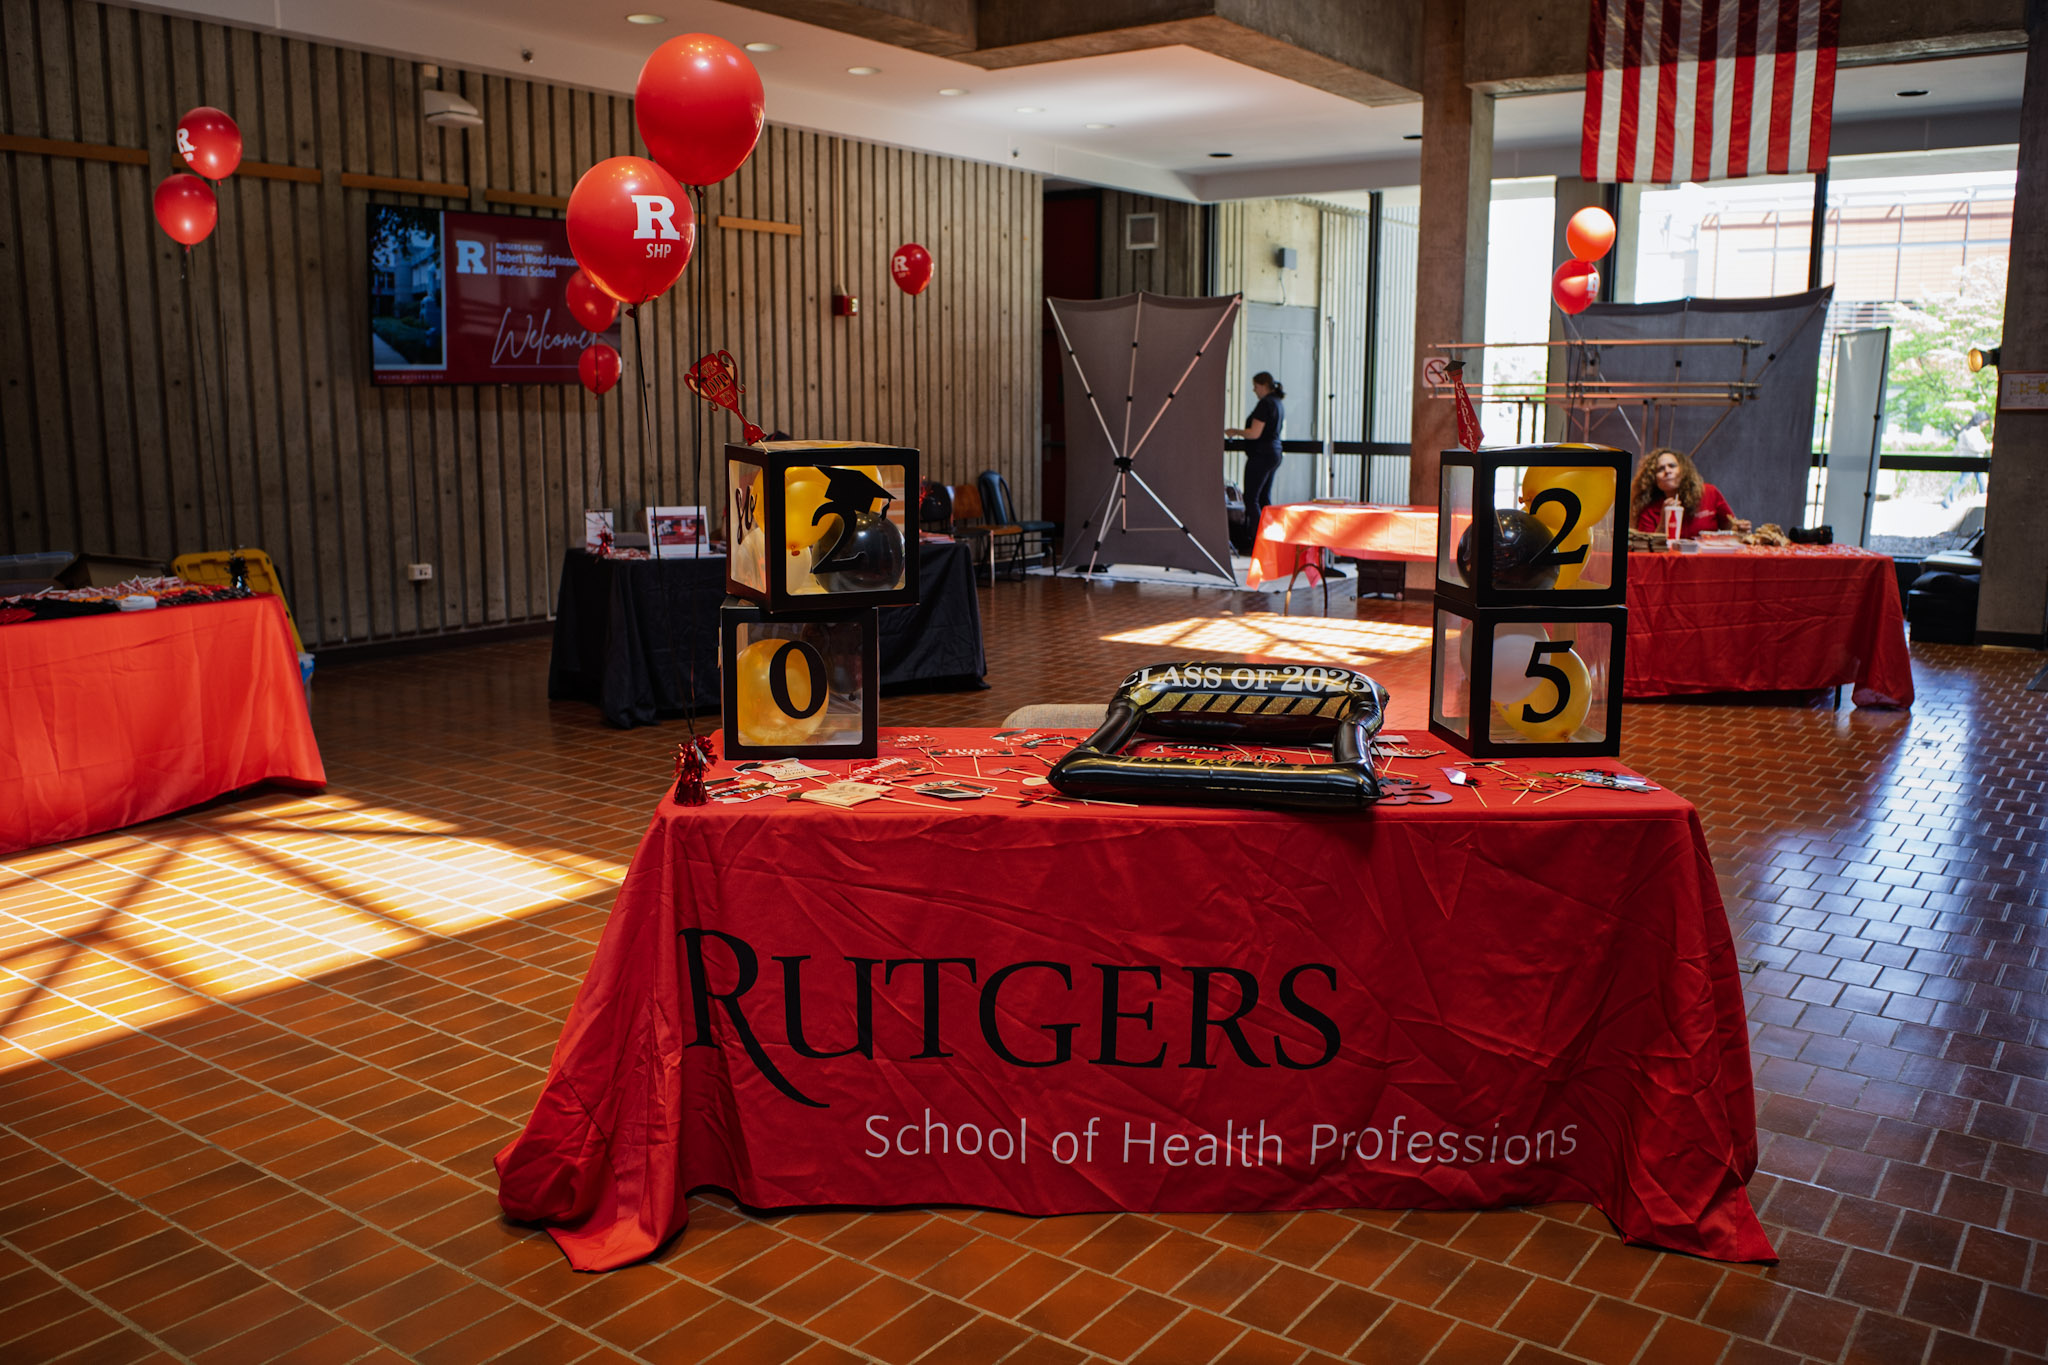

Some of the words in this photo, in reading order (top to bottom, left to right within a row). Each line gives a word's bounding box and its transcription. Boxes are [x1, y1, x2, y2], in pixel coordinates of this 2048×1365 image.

[631, 195, 680, 240] R
[456, 240, 488, 274] R
[645, 243, 671, 258] SHP
[894, 256, 910, 272] R
[1455, 381, 1476, 451] GRADUATE
[811, 500, 867, 575] 2
[1529, 488, 1589, 566] 2
[769, 640, 828, 720] 0
[1119, 666, 1223, 689] CLASS
[1230, 668, 1278, 690] OF
[1280, 666, 1372, 693] 2025
[1521, 640, 1575, 724] 5
[677, 927, 1342, 1108] RUTGERS
[865, 1108, 1027, 1164] School
[1052, 1117, 1100, 1164] of
[1123, 1119, 1283, 1168] Health
[1310, 1115, 1578, 1165] Professions
